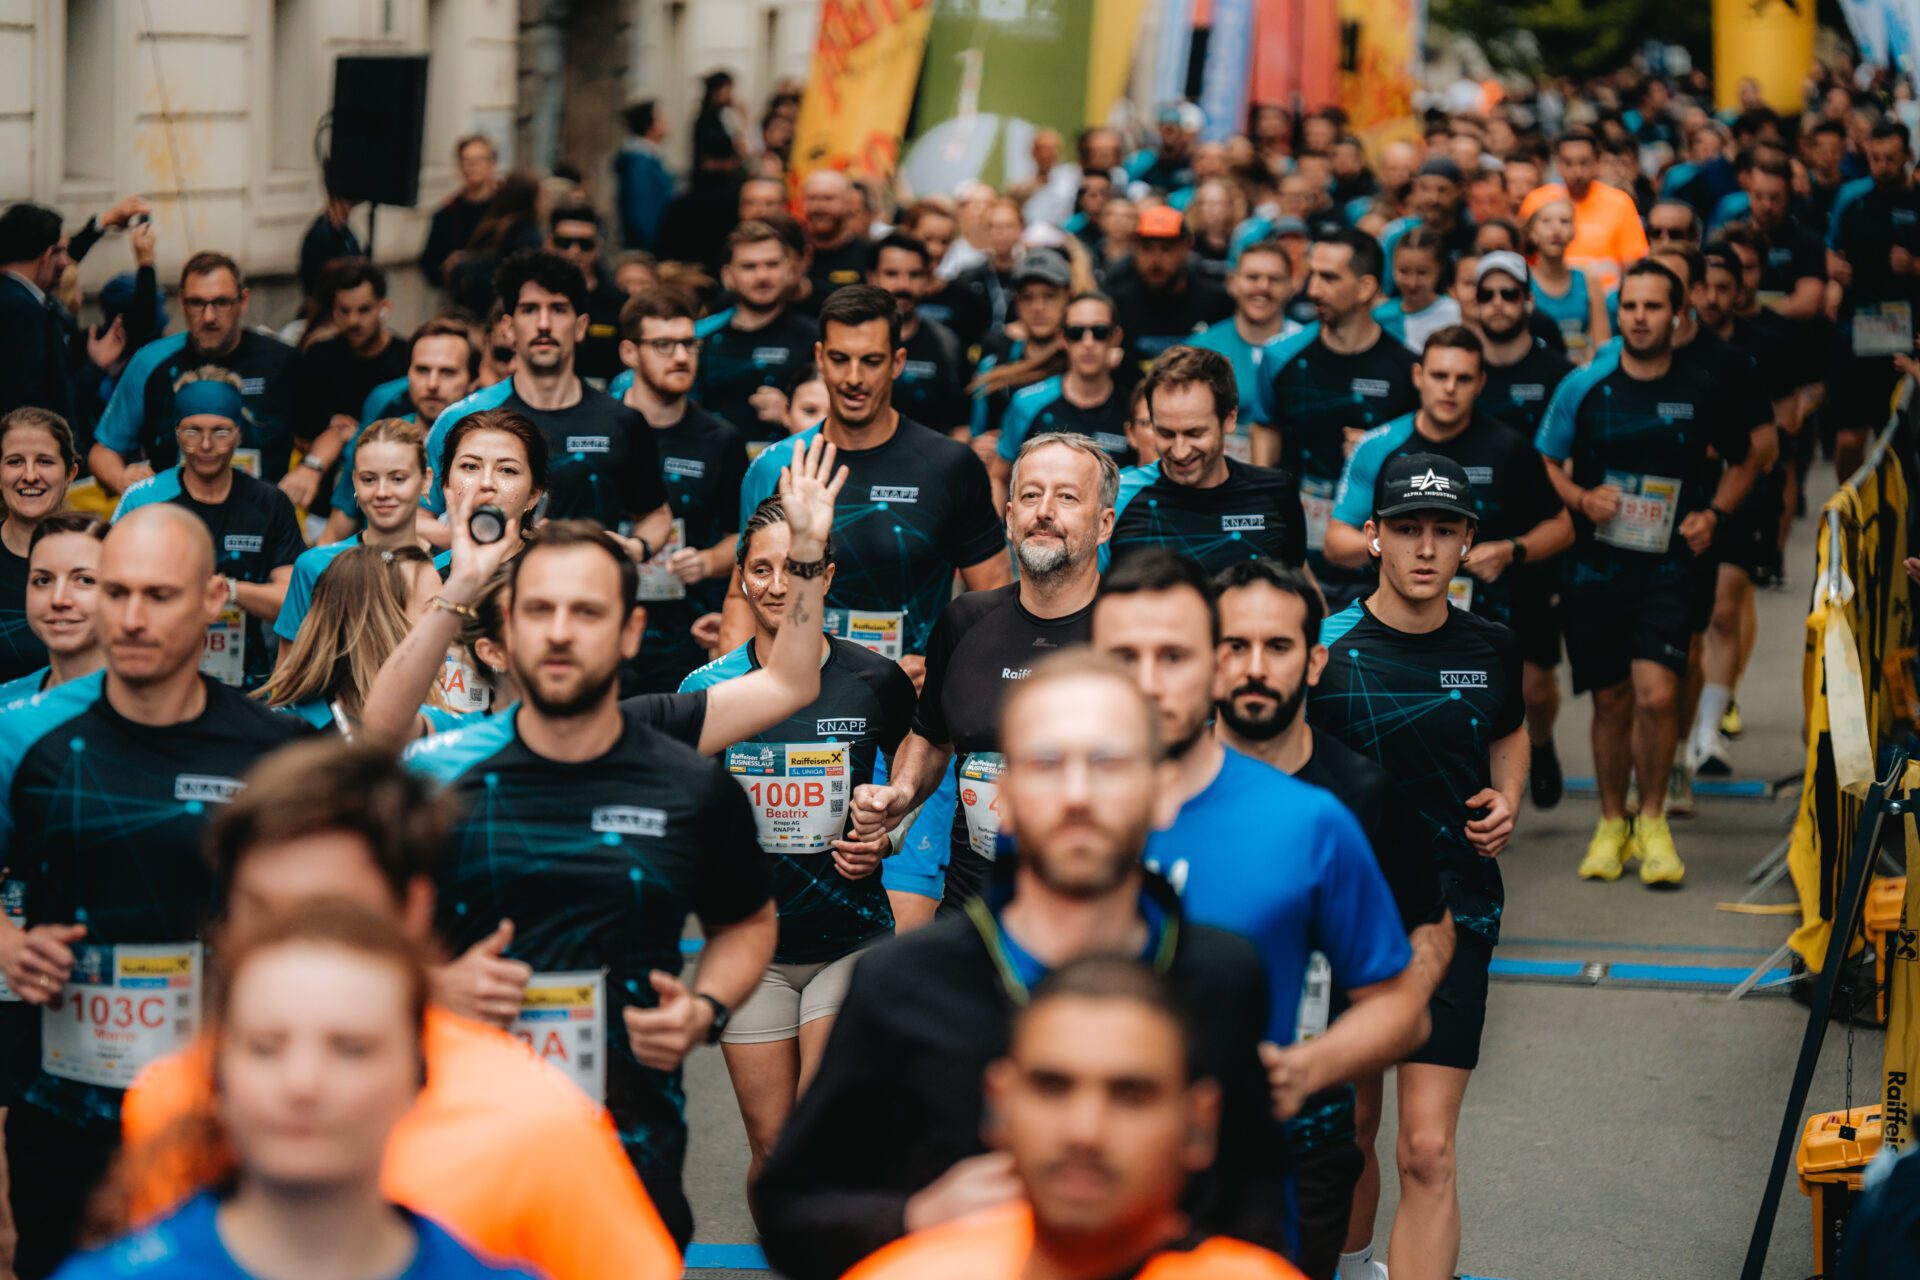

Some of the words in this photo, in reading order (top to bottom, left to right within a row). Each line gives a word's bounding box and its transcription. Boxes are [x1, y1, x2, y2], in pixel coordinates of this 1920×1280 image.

[870, 488, 919, 500] KNAPP
[1424, 491, 1457, 500] INDUSTRIES
[1222, 517, 1265, 528] KNAPP
[1440, 673, 1488, 685] KNAPP
[816, 720, 867, 732] KNAPP
[731, 753, 758, 761] Raiffeisen
[791, 756, 831, 765] Raiffeisen
[730, 760, 775, 768] BUSINESSLAUF
[750, 782, 825, 807] 100B
[766, 808, 808, 819] Beatrix
[72, 993, 166, 1028] 103C
